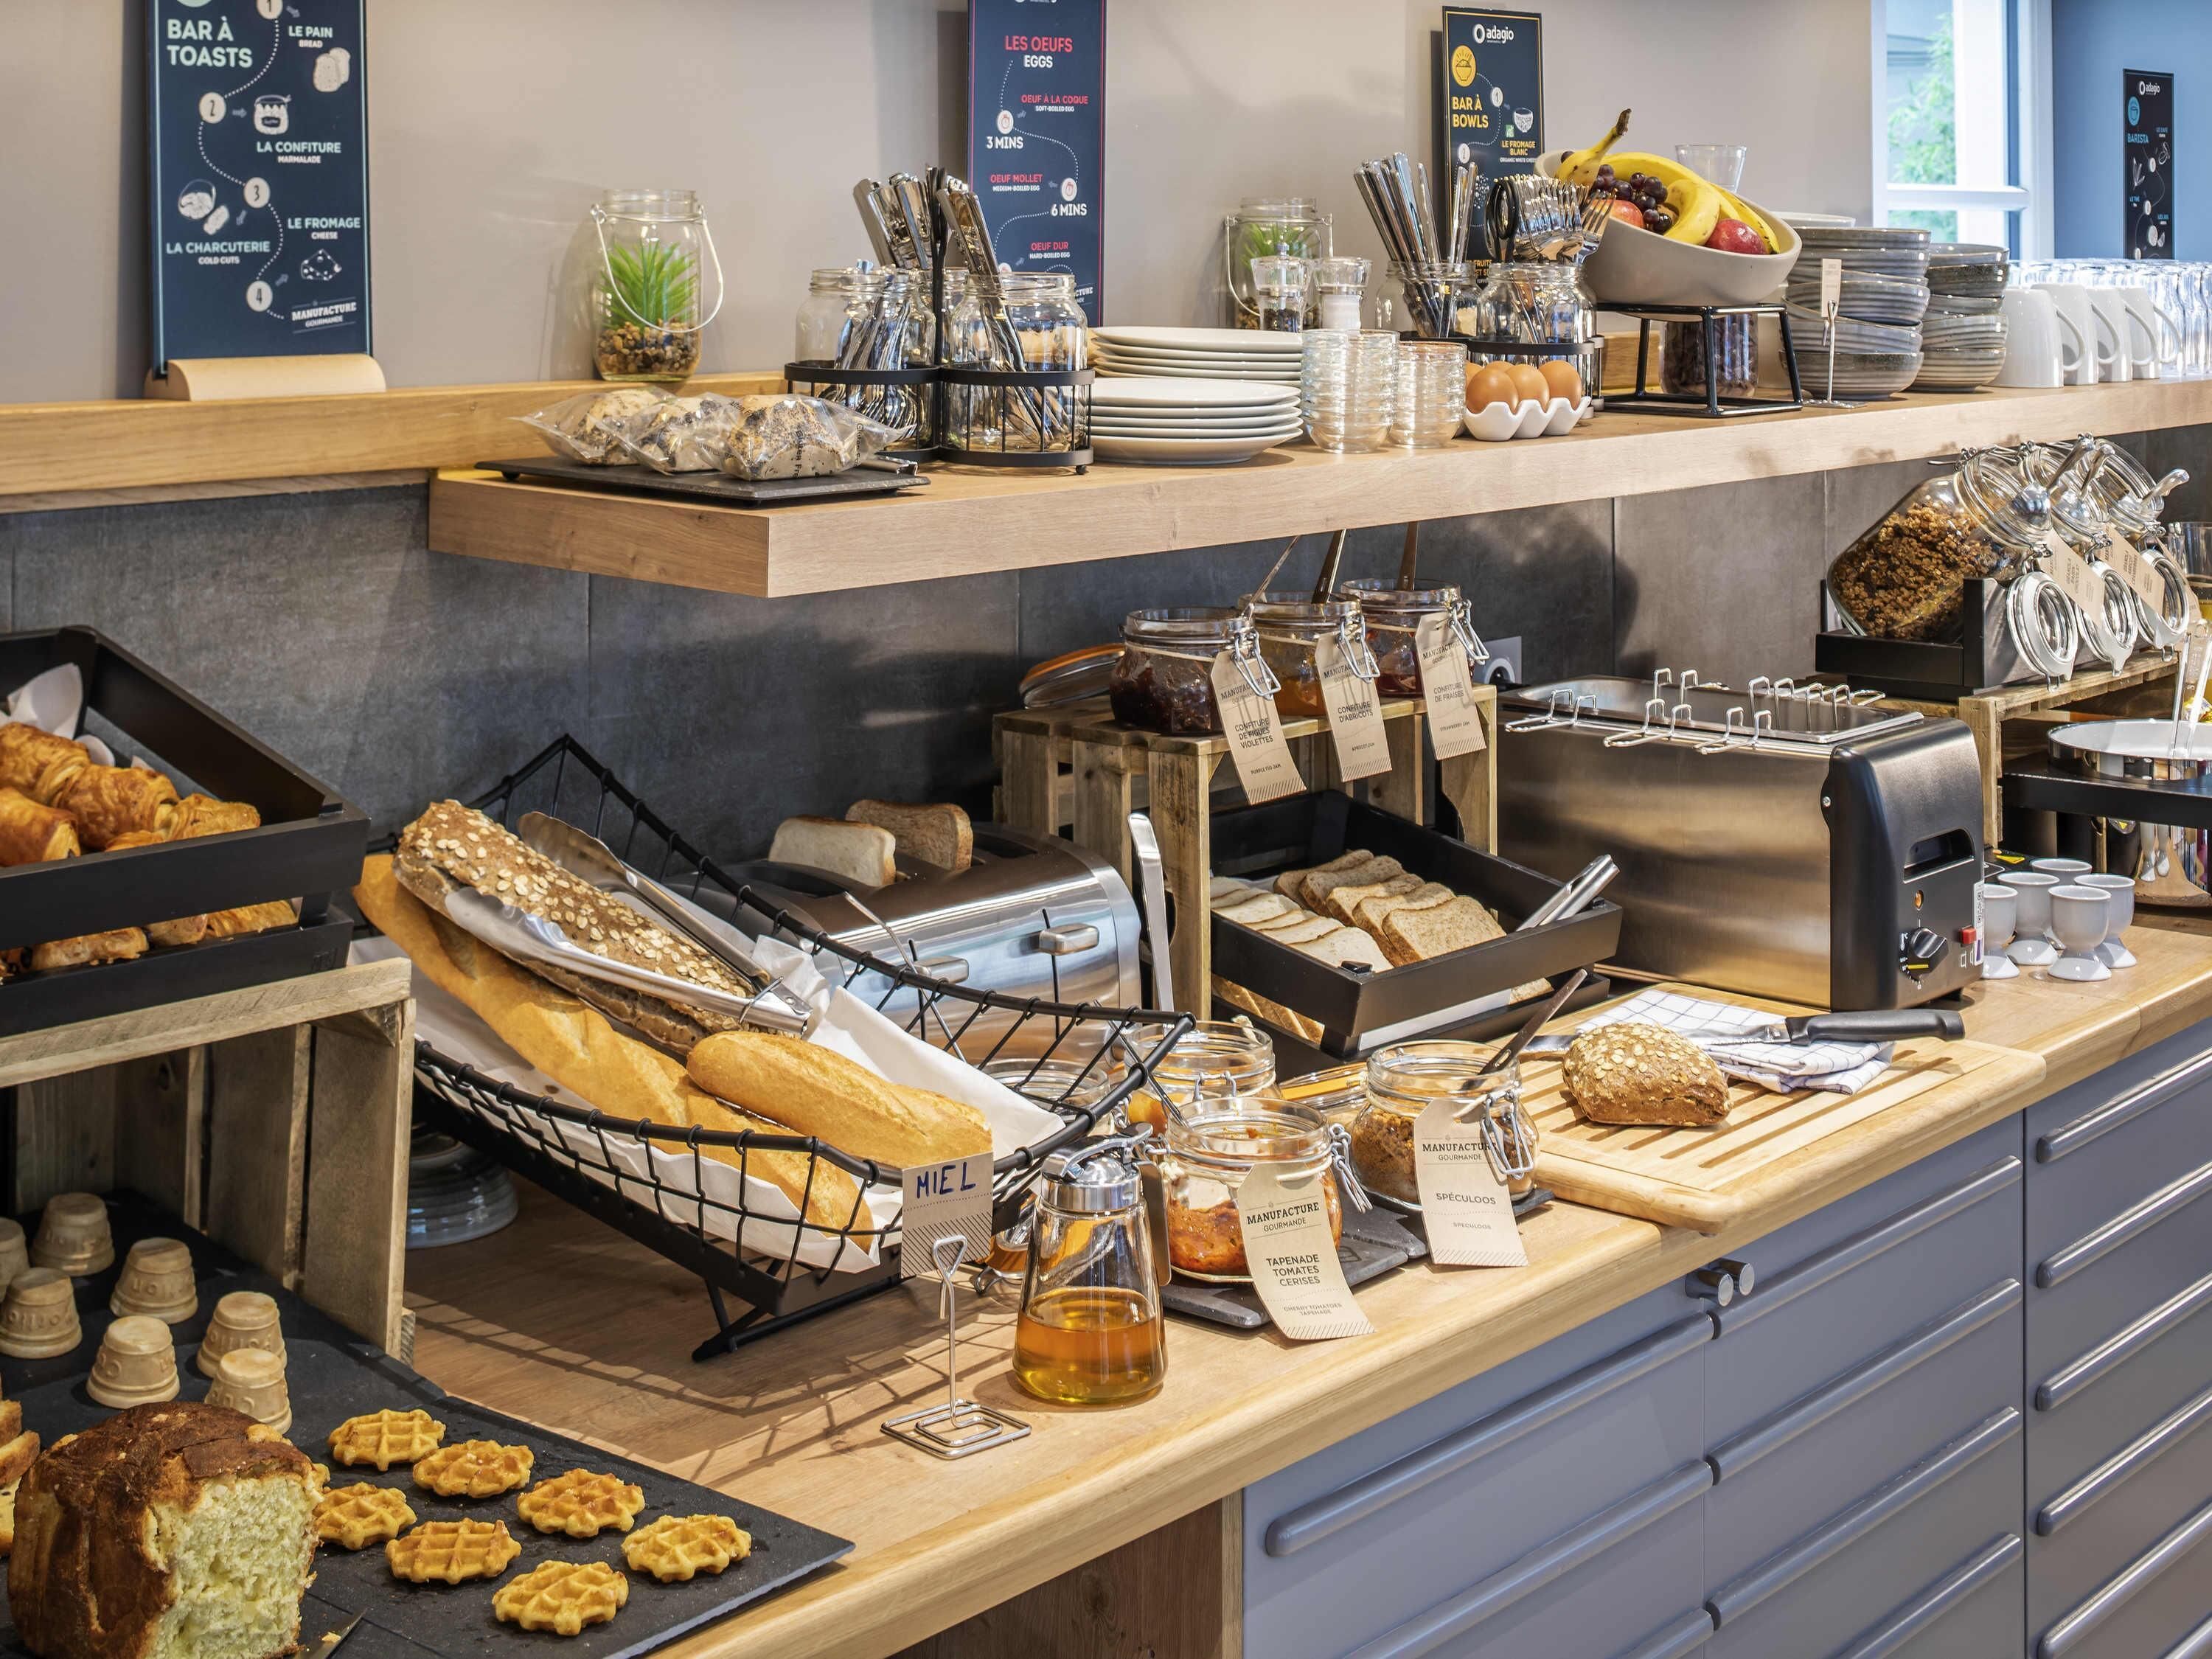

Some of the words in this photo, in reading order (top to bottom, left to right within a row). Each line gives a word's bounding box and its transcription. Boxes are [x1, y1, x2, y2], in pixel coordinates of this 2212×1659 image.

[167, 18, 213, 40] BAR
[217, 15, 234, 41] À
[288, 26, 303, 37] LE
[306, 27, 333, 38] PAIN
[1486, 25, 1514, 44] adagio
[299, 40, 323, 48] BREAD
[1004, 35, 1028, 51] LES
[1031, 36, 1073, 52] OEUFS
[167, 45, 253, 68] TOASTS
[1023, 55, 1053, 68] EGGS
[1020, 94, 1042, 104] OEUF
[1043, 93, 1049, 104] À
[1051, 95, 1061, 104] LA
[1062, 95, 1088, 105] COQUE
[1452, 97, 1472, 111] BAR
[1472, 94, 1483, 111] À
[209, 100, 215, 116] 2
[1453, 114, 1489, 128] BOWLS
[986, 136, 994, 149] 3
[995, 136, 1023, 149] MINS
[2127, 133, 2149, 144] BARISTA
[257, 142, 274, 153] LA
[276, 142, 341, 153] CONFITURE
[277, 155, 321, 164] MARMALADE
[990, 174, 1011, 184] OEUF
[1013, 174, 1043, 183] MOLLET
[254, 185, 260, 201] 3
[1051, 204, 1058, 217] 6
[1060, 204, 1088, 216] MINS
[288, 218, 302, 229] LE
[305, 218, 361, 229] FROMAGE
[311, 232, 338, 240] CHEESE
[166, 243, 183, 254] LA
[186, 241, 271, 253] CHARCUTERIE
[1031, 242, 1051, 251] OEUF
[1053, 241, 1069, 251] DUR
[198, 257, 220, 265] COLD
[220, 256, 240, 264] CUTS
[256, 288, 262, 304] 4
[291, 302, 357, 321] MANUFACTURE
[1433, 682, 1463, 695] CONFITURE
[1434, 695, 1442, 703] DE
[1443, 690, 1464, 700] FRAISES
[1338, 702, 1371, 714] CONFITURE
[1338, 710, 1374, 723] D'ABRICOTS
[1234, 717, 1269, 732] CONFITURE
[1239, 732, 1248, 740] DE
[1248, 726, 1270, 738] FIGUES
[1240, 735, 1274, 749] VIOLETTES
[917, 1162, 976, 1199] MIEL
[1436, 1192, 1496, 1205] SPÉCULOOS
[1247, 1202, 1320, 1225] MANUFACTURE
[1263, 1217, 1307, 1232] GOURMANDE
[1266, 1253, 1320, 1267] TAPENADE
[1273, 1265, 1320, 1277] TOMATES
[1279, 1276, 1321, 1287] CERISES
